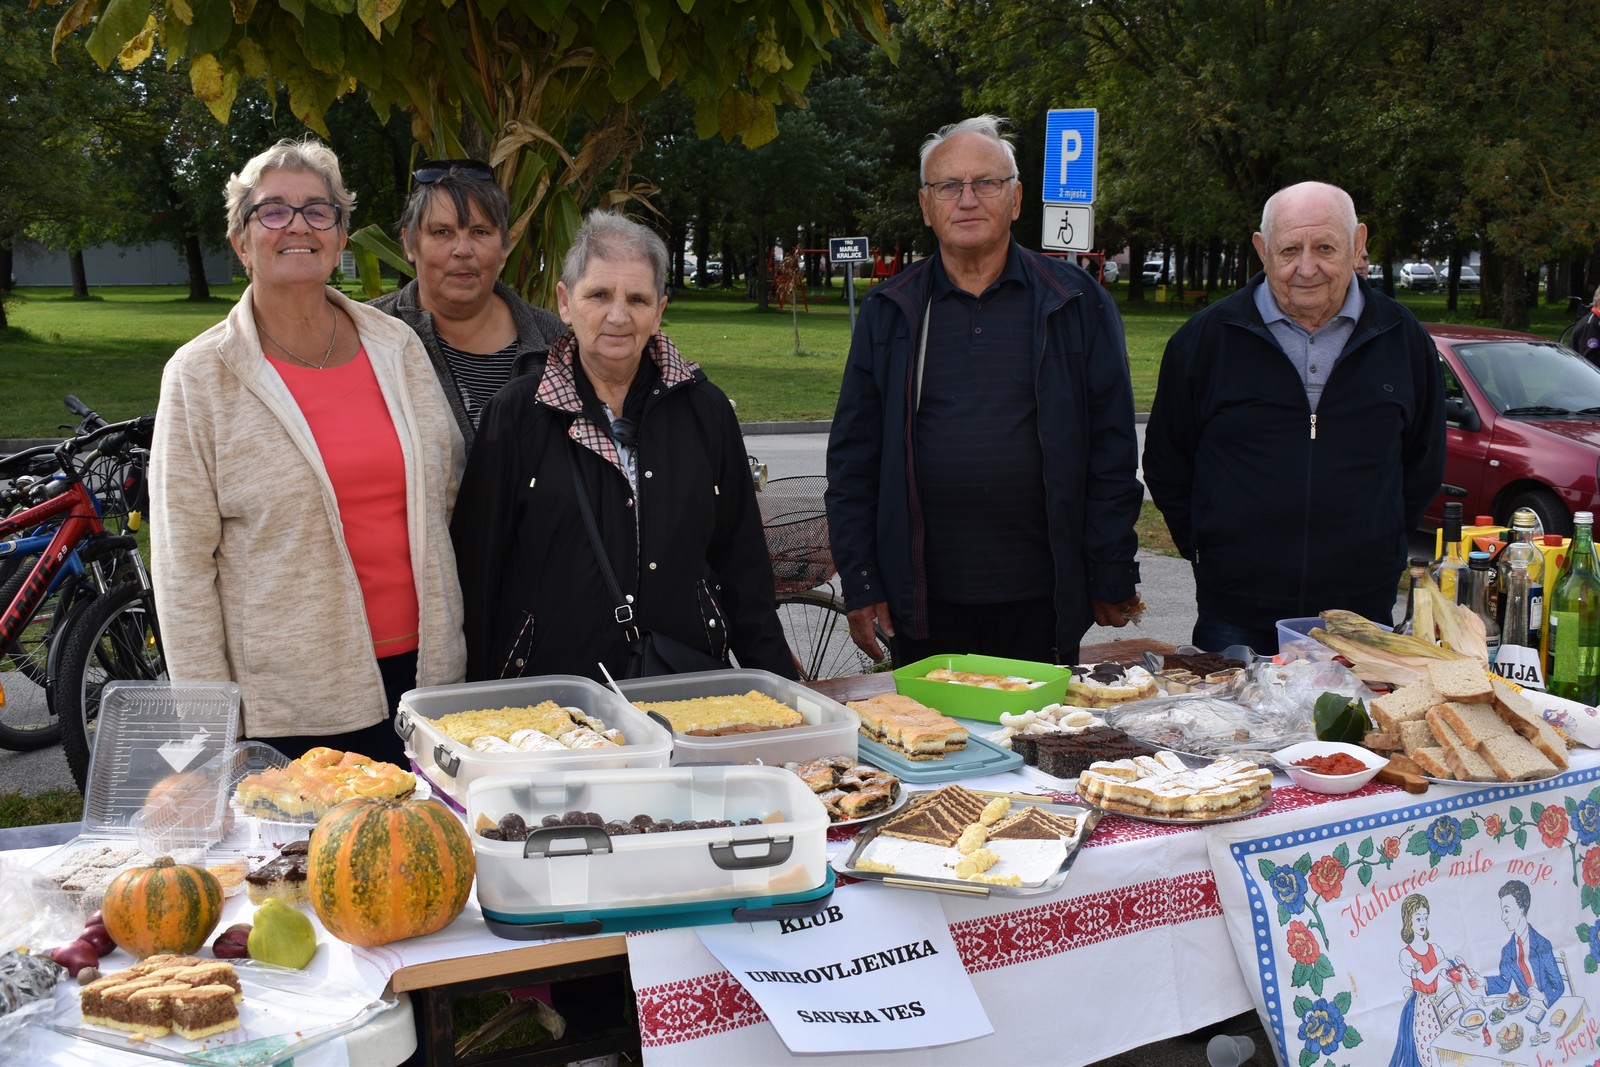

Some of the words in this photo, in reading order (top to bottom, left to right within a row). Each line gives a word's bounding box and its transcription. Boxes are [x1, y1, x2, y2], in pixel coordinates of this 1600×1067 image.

[1060, 129, 1082, 185] P
[1059, 188, 1064, 198] 2
[1065, 189, 1087, 200] mjesta
[57, 545, 68, 561] 29
[1341, 865, 1439, 938] Kuharice
[1449, 848, 1495, 878] milo
[1507, 855, 1559, 887] moje,
[777, 905, 844, 935] KLUB
[744, 939, 939, 984] UMIROVLJENIKA
[797, 1009, 881, 1024] SAVSKA
[878, 1000, 926, 1022] VES
